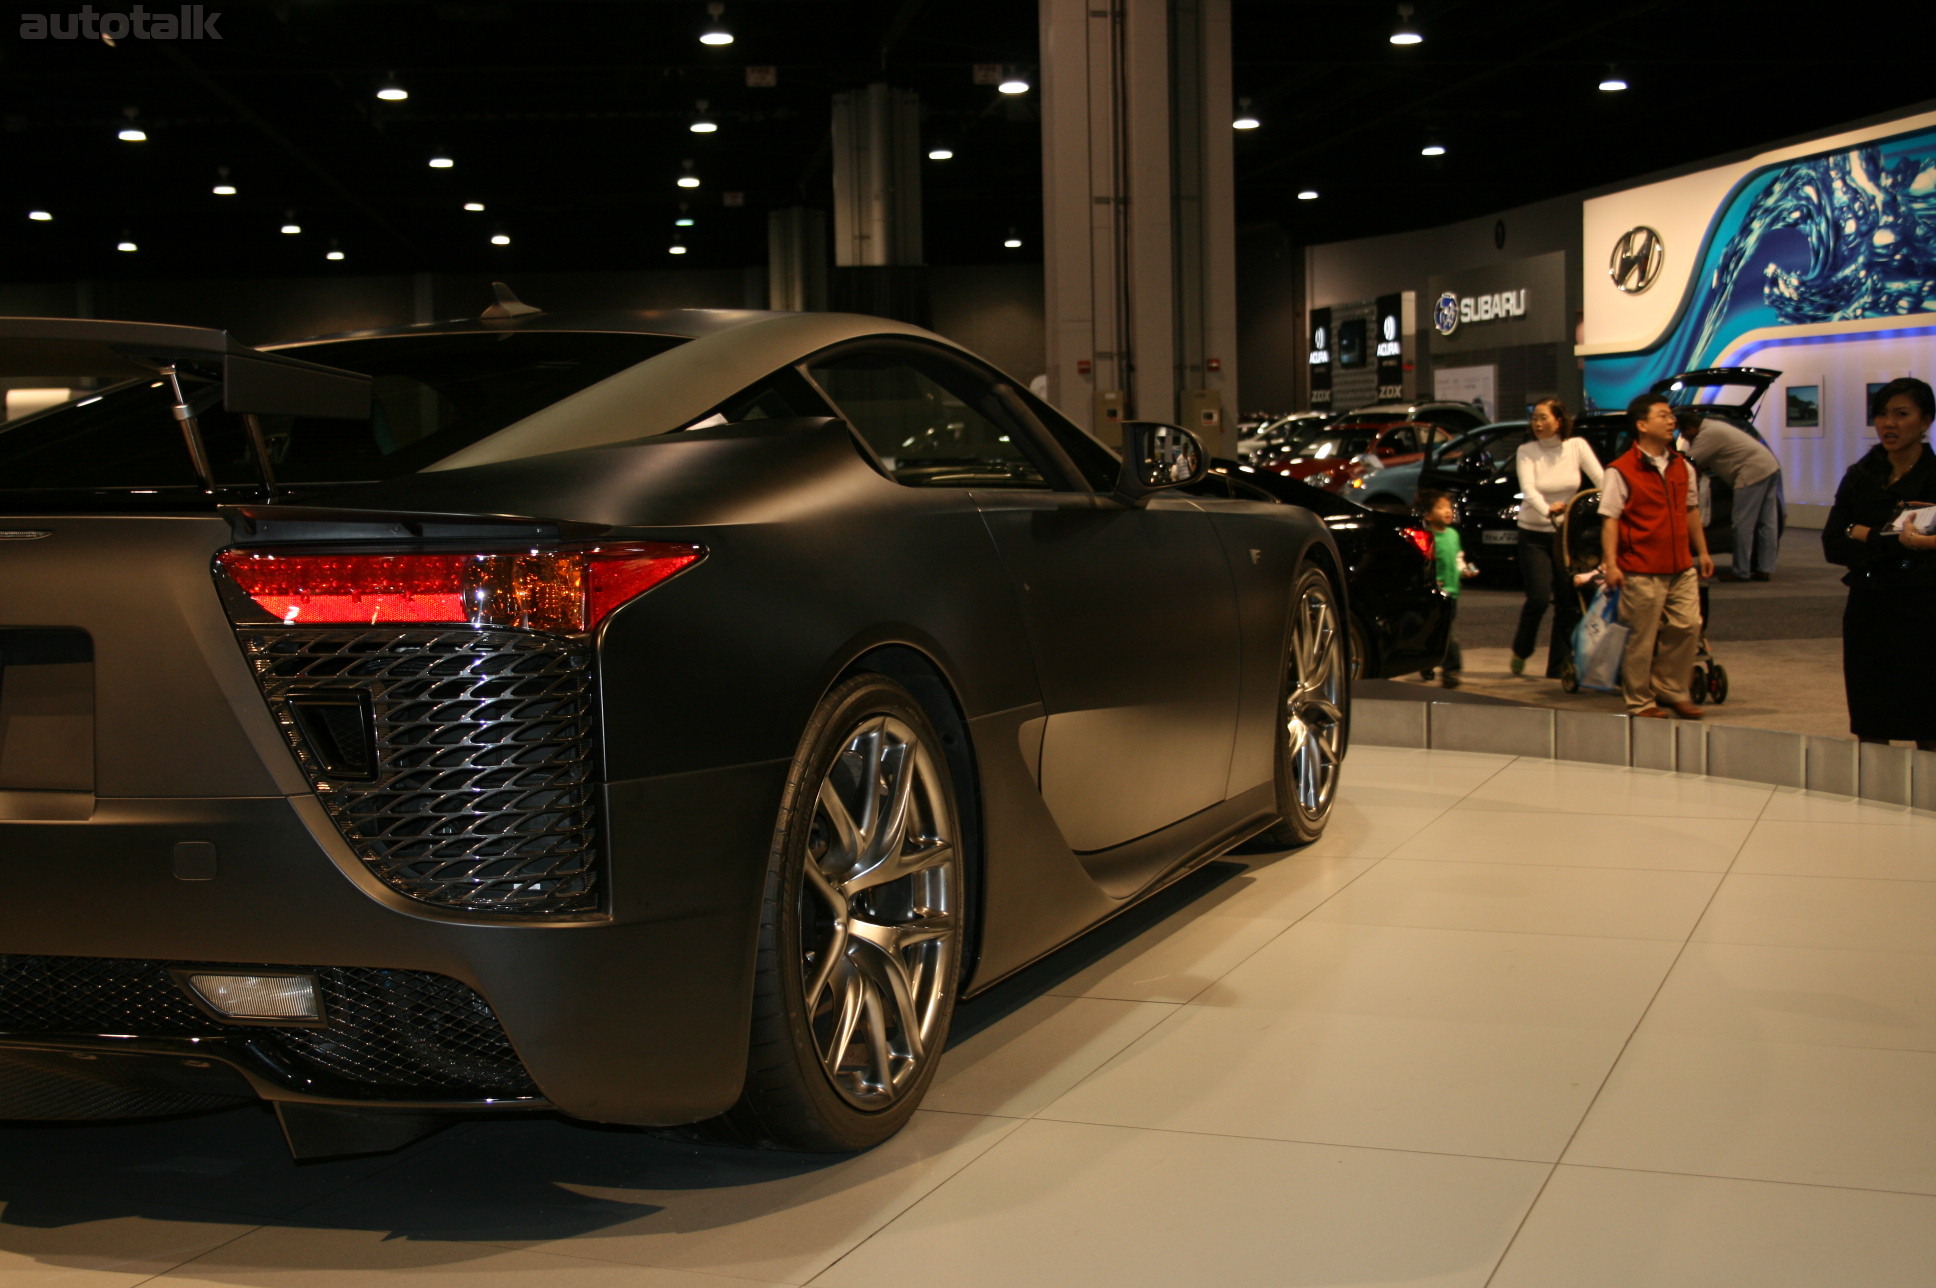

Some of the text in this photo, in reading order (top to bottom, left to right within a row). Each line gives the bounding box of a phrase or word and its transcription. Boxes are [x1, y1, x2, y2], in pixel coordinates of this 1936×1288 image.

[1460, 288, 1526, 323] SUBARU
[1376, 341, 1401, 357] ACURA
[1309, 350, 1330, 364] ACURA
[1379, 385, 1402, 399] ZDX
